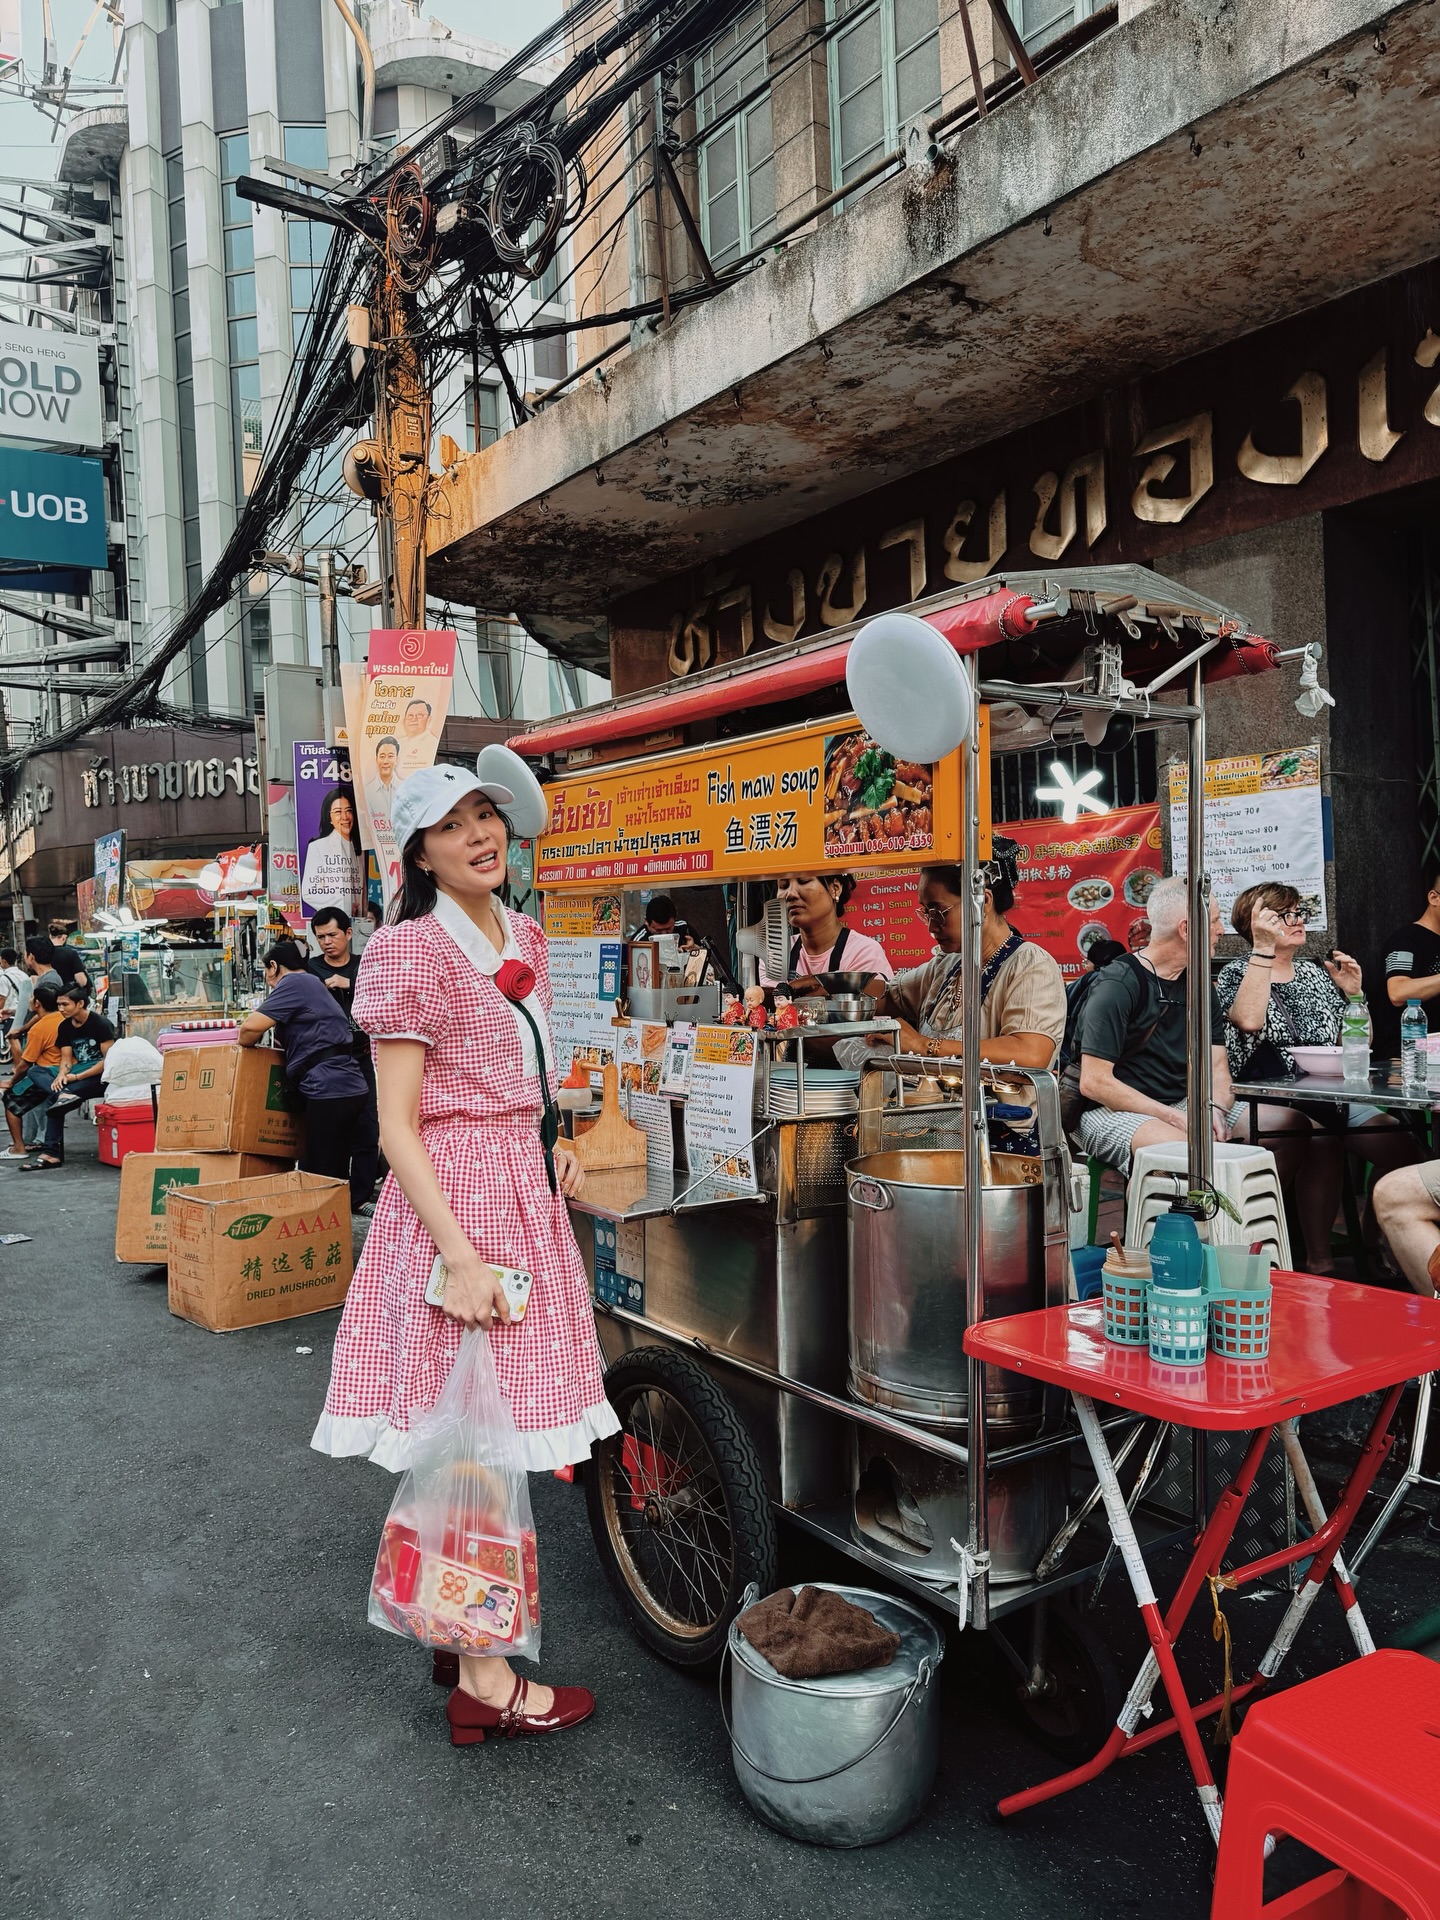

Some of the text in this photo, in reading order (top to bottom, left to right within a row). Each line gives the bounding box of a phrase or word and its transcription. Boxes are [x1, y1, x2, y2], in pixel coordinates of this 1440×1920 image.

[5, 342, 66, 359] SENG HENG
[11, 490, 88, 524] UOB
[372, 661, 449, 675] พรรคโอกาสใหม่
[707, 765, 820, 806] Fish maw soup
[724, 810, 799, 855] 鱼漂汤
[866, 833, 933, 852] 086-619-4359
[565, 866, 575, 879] 70
[613, 862, 624, 875] 80
[691, 854, 708, 870] 100
[870, 885, 901, 895] Chinese
[889, 899, 913, 909] Small
[889, 917, 913, 926] Large
[889, 932, 907, 942] Egg
[276, 1210, 341, 1240] AAAA
[246, 1274, 336, 1301] DRIED MUSHROOM
